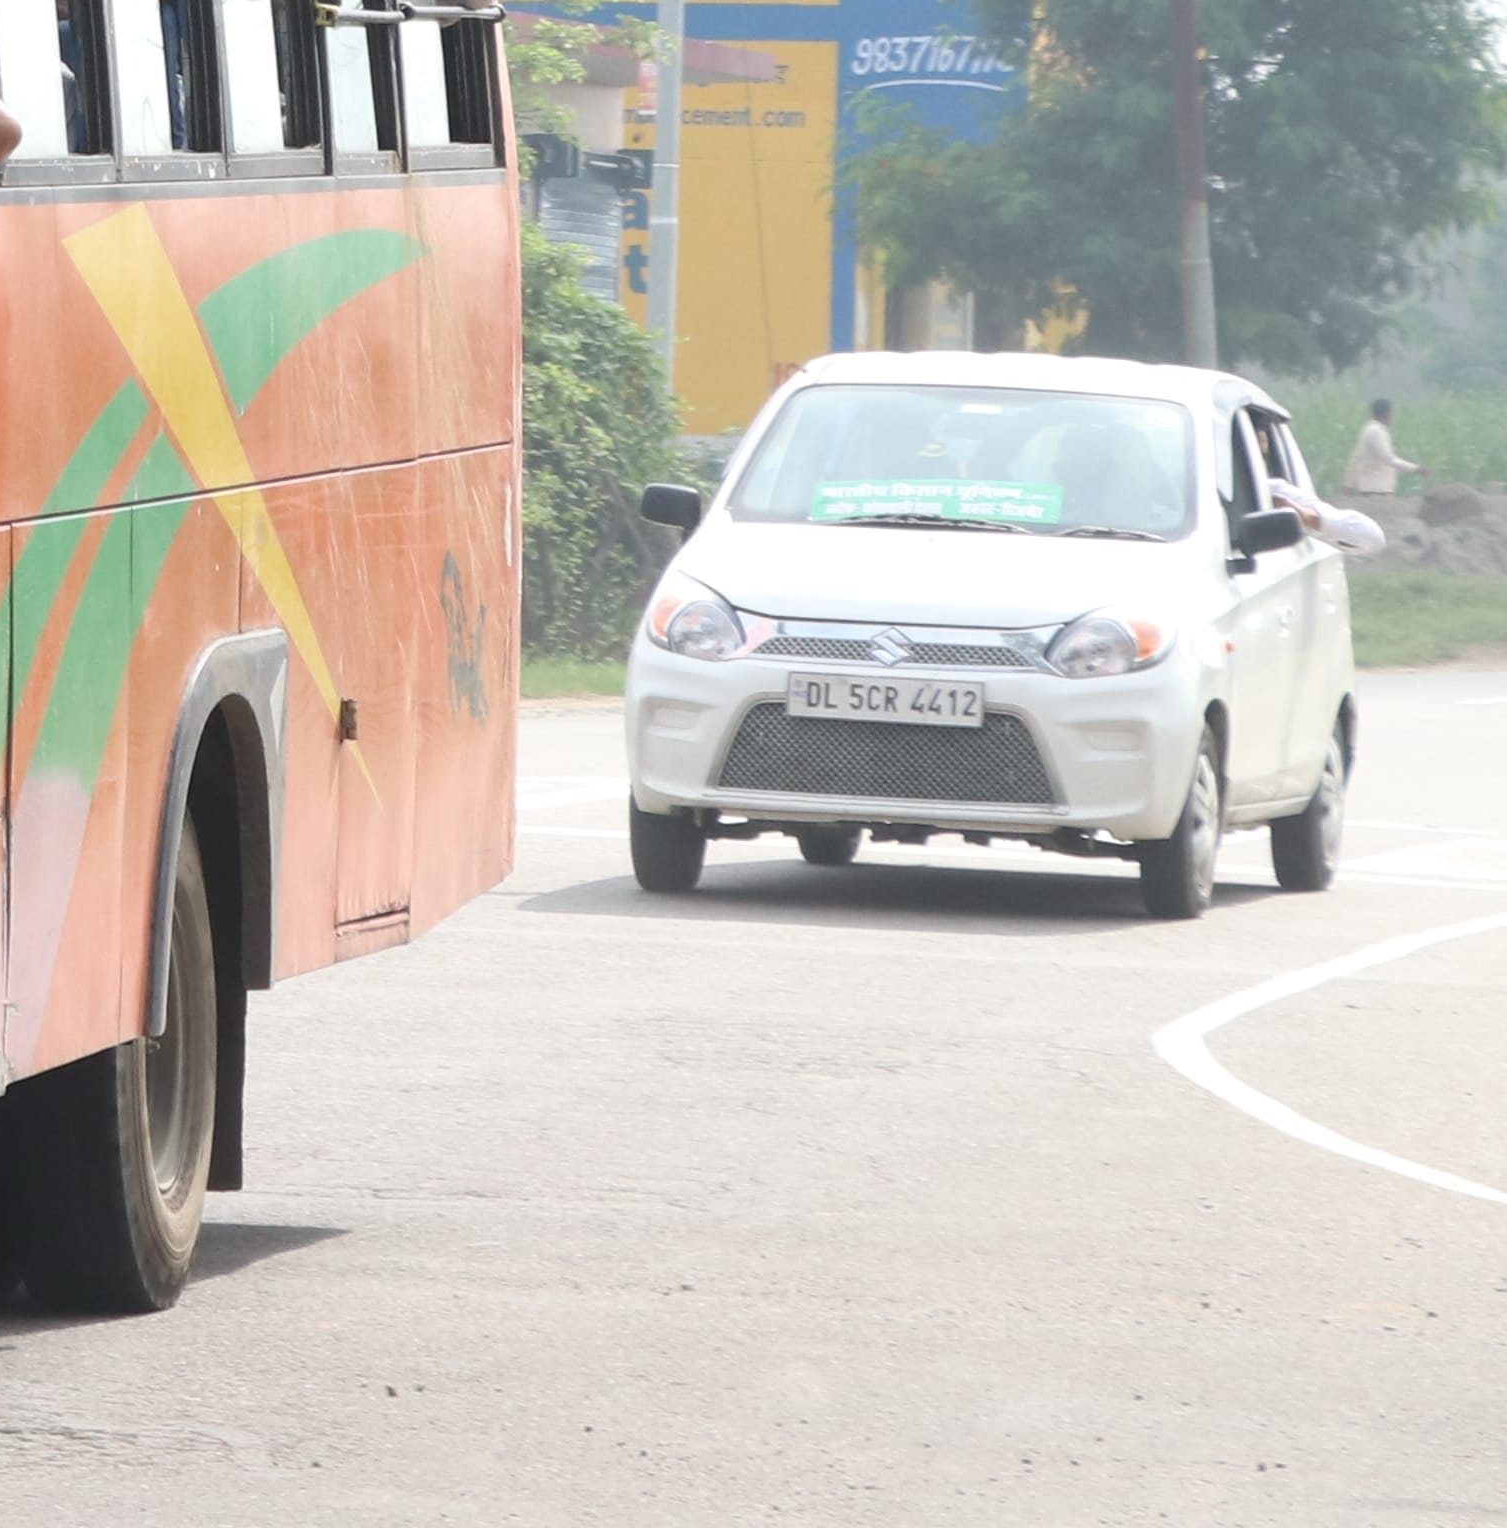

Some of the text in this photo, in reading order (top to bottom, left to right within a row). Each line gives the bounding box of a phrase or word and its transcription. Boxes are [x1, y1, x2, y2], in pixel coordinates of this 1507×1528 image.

[806, 681, 978, 717] DL 5CR 4412
